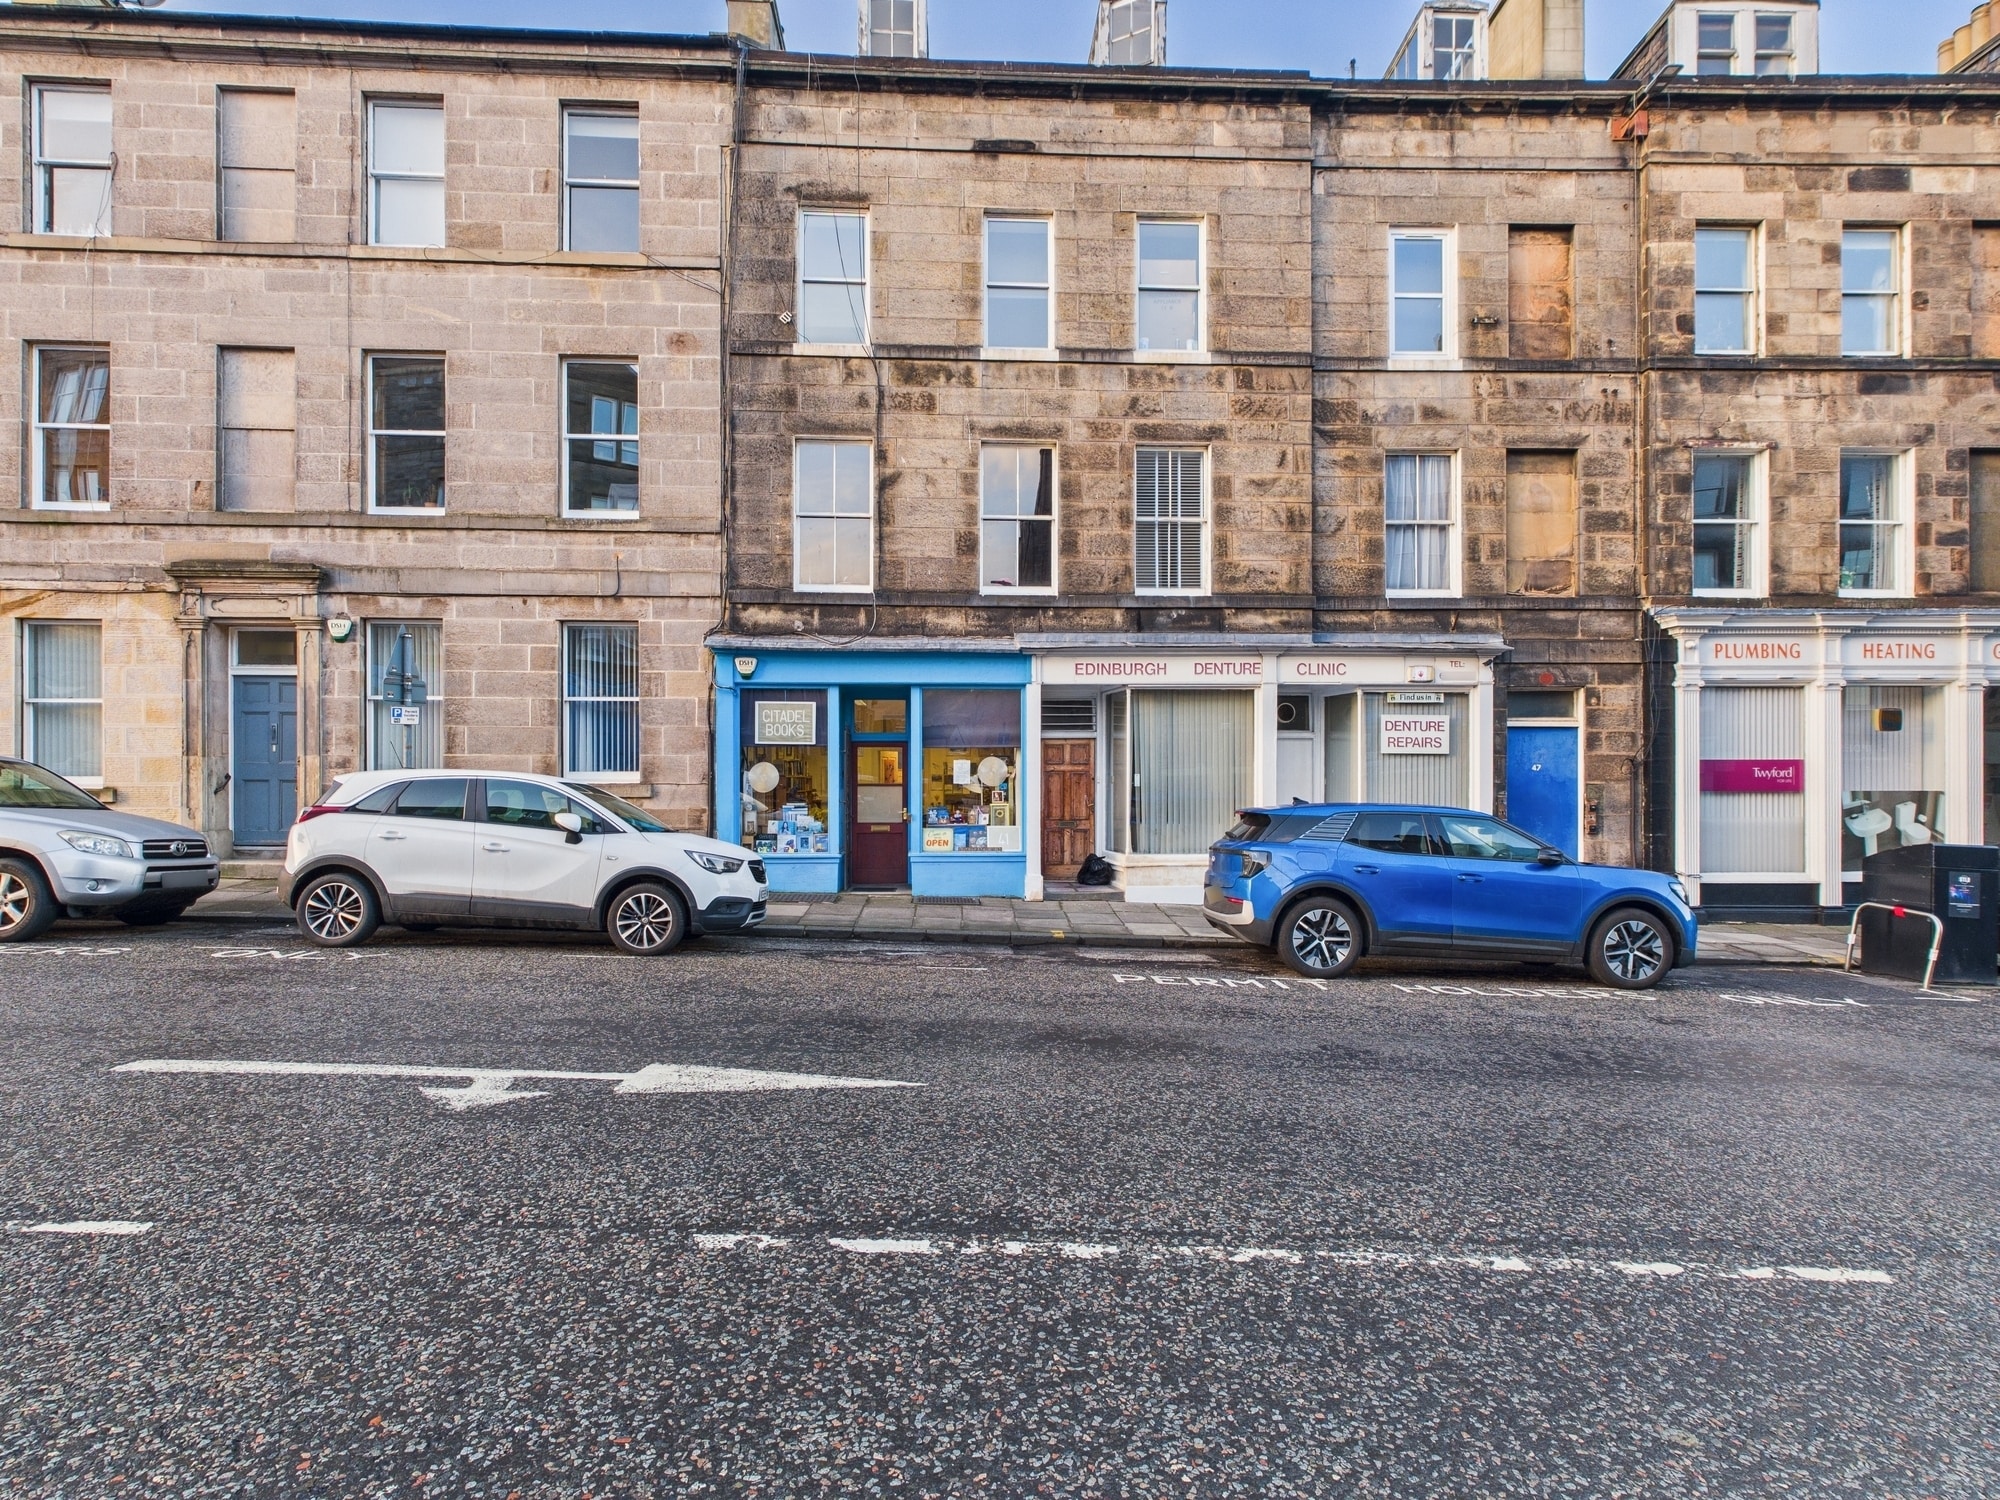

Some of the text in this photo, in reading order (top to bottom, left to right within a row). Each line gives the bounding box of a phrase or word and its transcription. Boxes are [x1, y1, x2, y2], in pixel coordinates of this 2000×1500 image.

[1714, 643, 1801, 659] PLUMBING
[1863, 643, 1935, 659] HEATING
[1074, 662, 1347, 676] EDINBURGH DENTURE CLINIC
[1400, 693, 1415, 701] Find
[762, 709, 810, 723] CITADEL
[765, 723, 805, 737] BOOKS
[1384, 720, 1445, 732] DENTURE
[1387, 736, 1443, 748] REPAIRS
[1752, 766, 1793, 780] Twyford
[926, 839, 949, 847] OPEN
[210, 949, 393, 960] ONLY
[1112, 973, 1870, 1007] PERMIT HOLDERS ONLY
